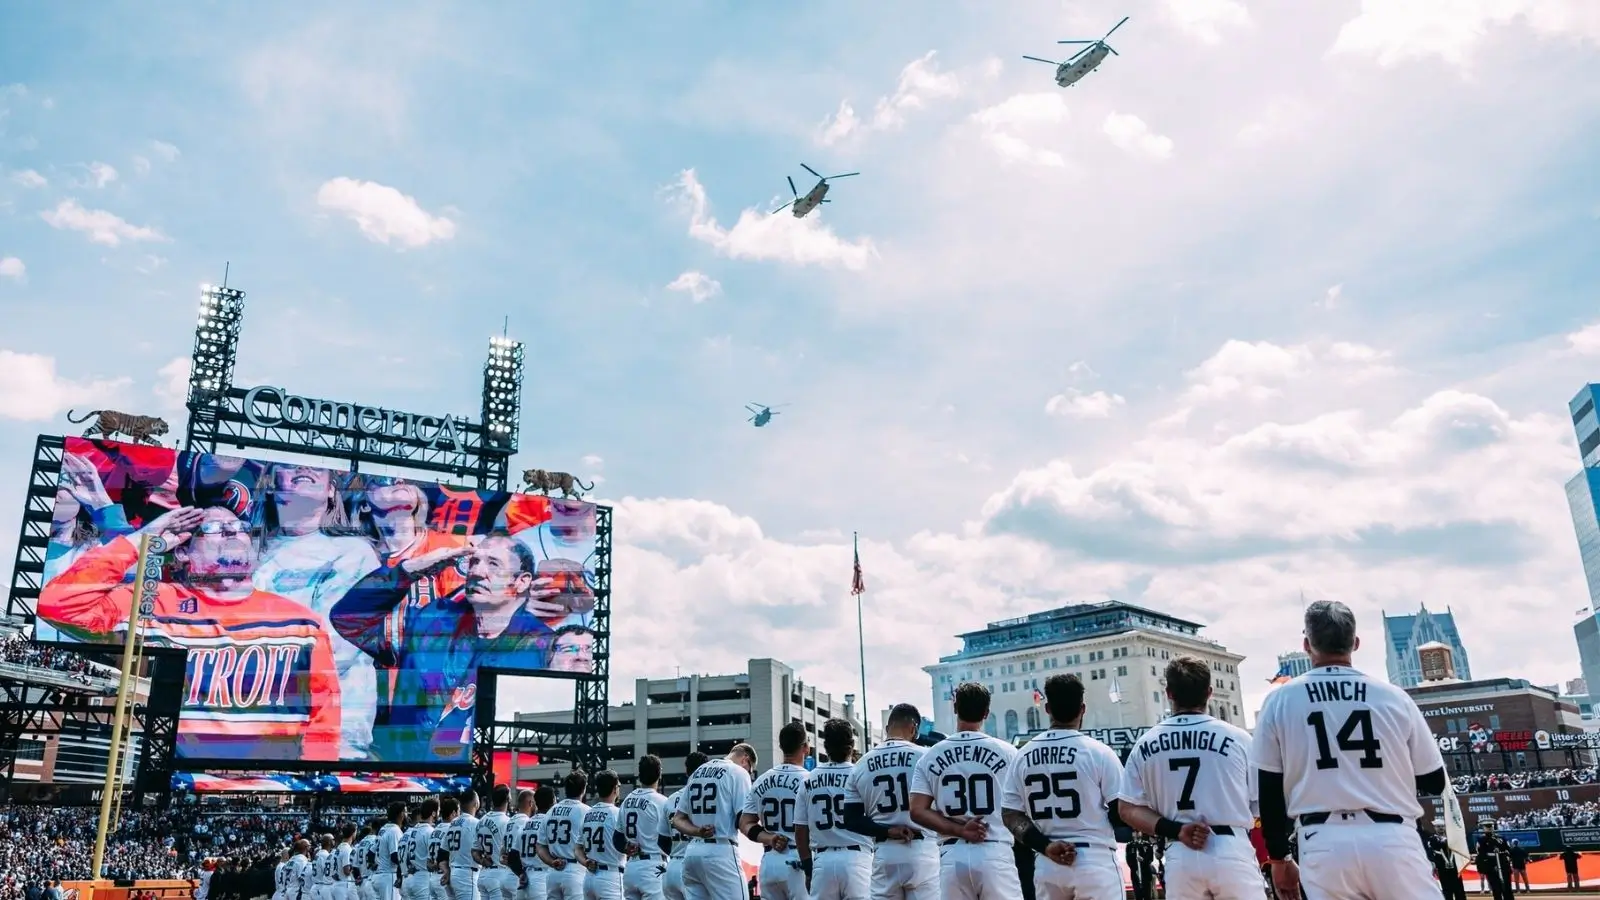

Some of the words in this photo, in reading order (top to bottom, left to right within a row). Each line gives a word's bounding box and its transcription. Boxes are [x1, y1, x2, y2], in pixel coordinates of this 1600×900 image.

[307, 429, 408, 457] PARK
[138, 552, 165, 621] Rocket
[143, 640, 300, 708] TROIT
[1305, 680, 1366, 703] HINCH
[1440, 703, 1494, 714] UNIVERSITY
[1307, 710, 1383, 770] 14
[1500, 740, 1528, 750] TIRE
[867, 752, 915, 772] GREENE
[929, 745, 1006, 777] CARPENTER
[1024, 746, 1077, 767] TORRES
[689, 782, 717, 814] 22
[872, 772, 911, 813] 31
[941, 773, 995, 816] 30
[1024, 771, 1081, 820] 25
[1168, 757, 1200, 811] 7
[1556, 790, 1570, 801] 10
[552, 806, 572, 816] KEITH
[625, 811, 638, 839] 8
[761, 797, 796, 832] 20
[446, 830, 462, 852] 29
[521, 834, 538, 857] 18
[547, 820, 572, 845] 33
[583, 826, 606, 853] 34
